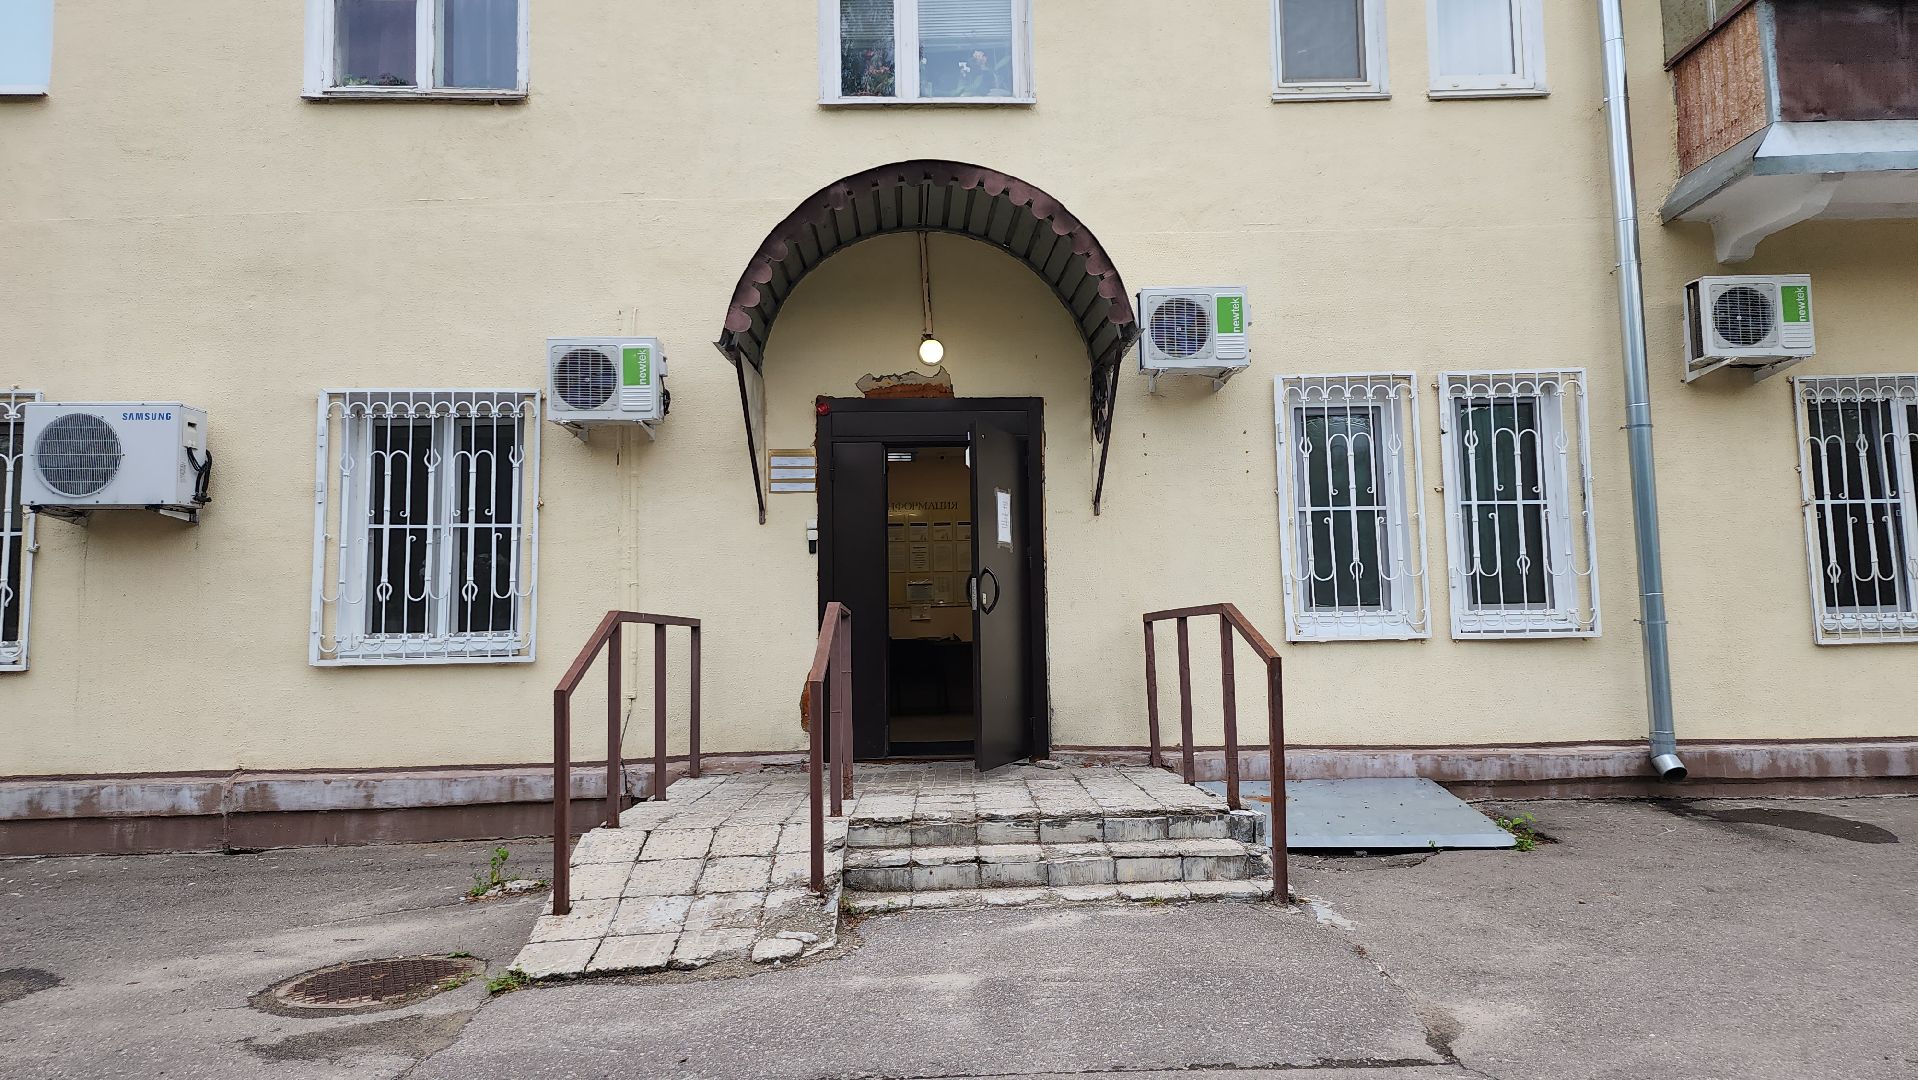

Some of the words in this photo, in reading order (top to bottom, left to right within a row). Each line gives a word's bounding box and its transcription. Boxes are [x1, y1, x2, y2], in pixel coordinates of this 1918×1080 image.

[1230, 297, 1240, 333] newtek
[1795, 287, 1806, 321] newtek
[637, 347, 647, 385] newtek
[122, 412, 172, 421] SAMSUNG
